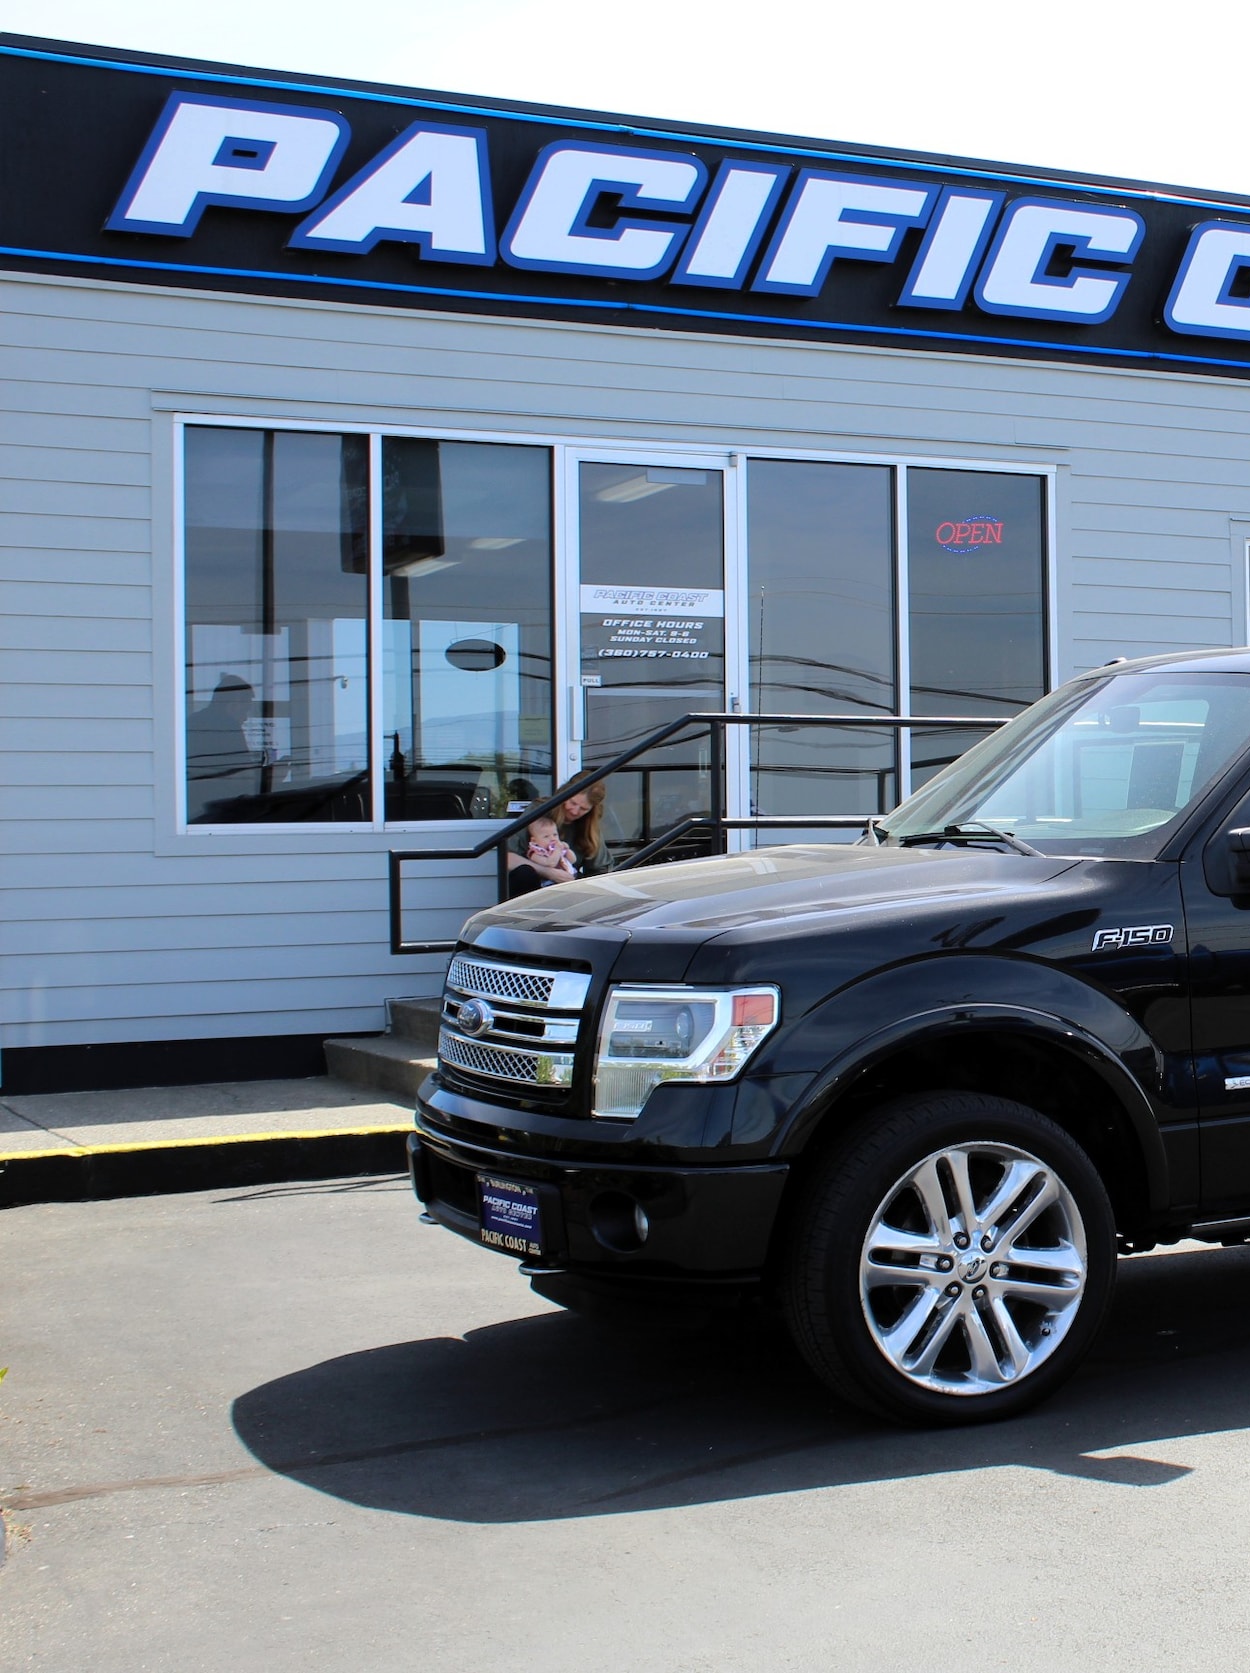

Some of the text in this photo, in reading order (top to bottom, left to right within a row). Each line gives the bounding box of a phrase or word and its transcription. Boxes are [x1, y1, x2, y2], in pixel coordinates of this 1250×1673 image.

[105, 90, 1146, 325] PACIFIC
[936, 521, 1004, 544] OPEN
[593, 589, 709, 602] PACIFIC COAST
[602, 619, 704, 630] OFFICE HOURS
[609, 635, 653, 643] SUNDAY
[617, 629, 667, 637] MON-SAT.
[598, 649, 709, 659] (360)757-0400
[483, 1195, 511, 1209] PACIFIC
[511, 1201, 538, 1215] COAST
[481, 1228, 504, 1247] PACIFIC
[504, 1234, 526, 1252] COAST
